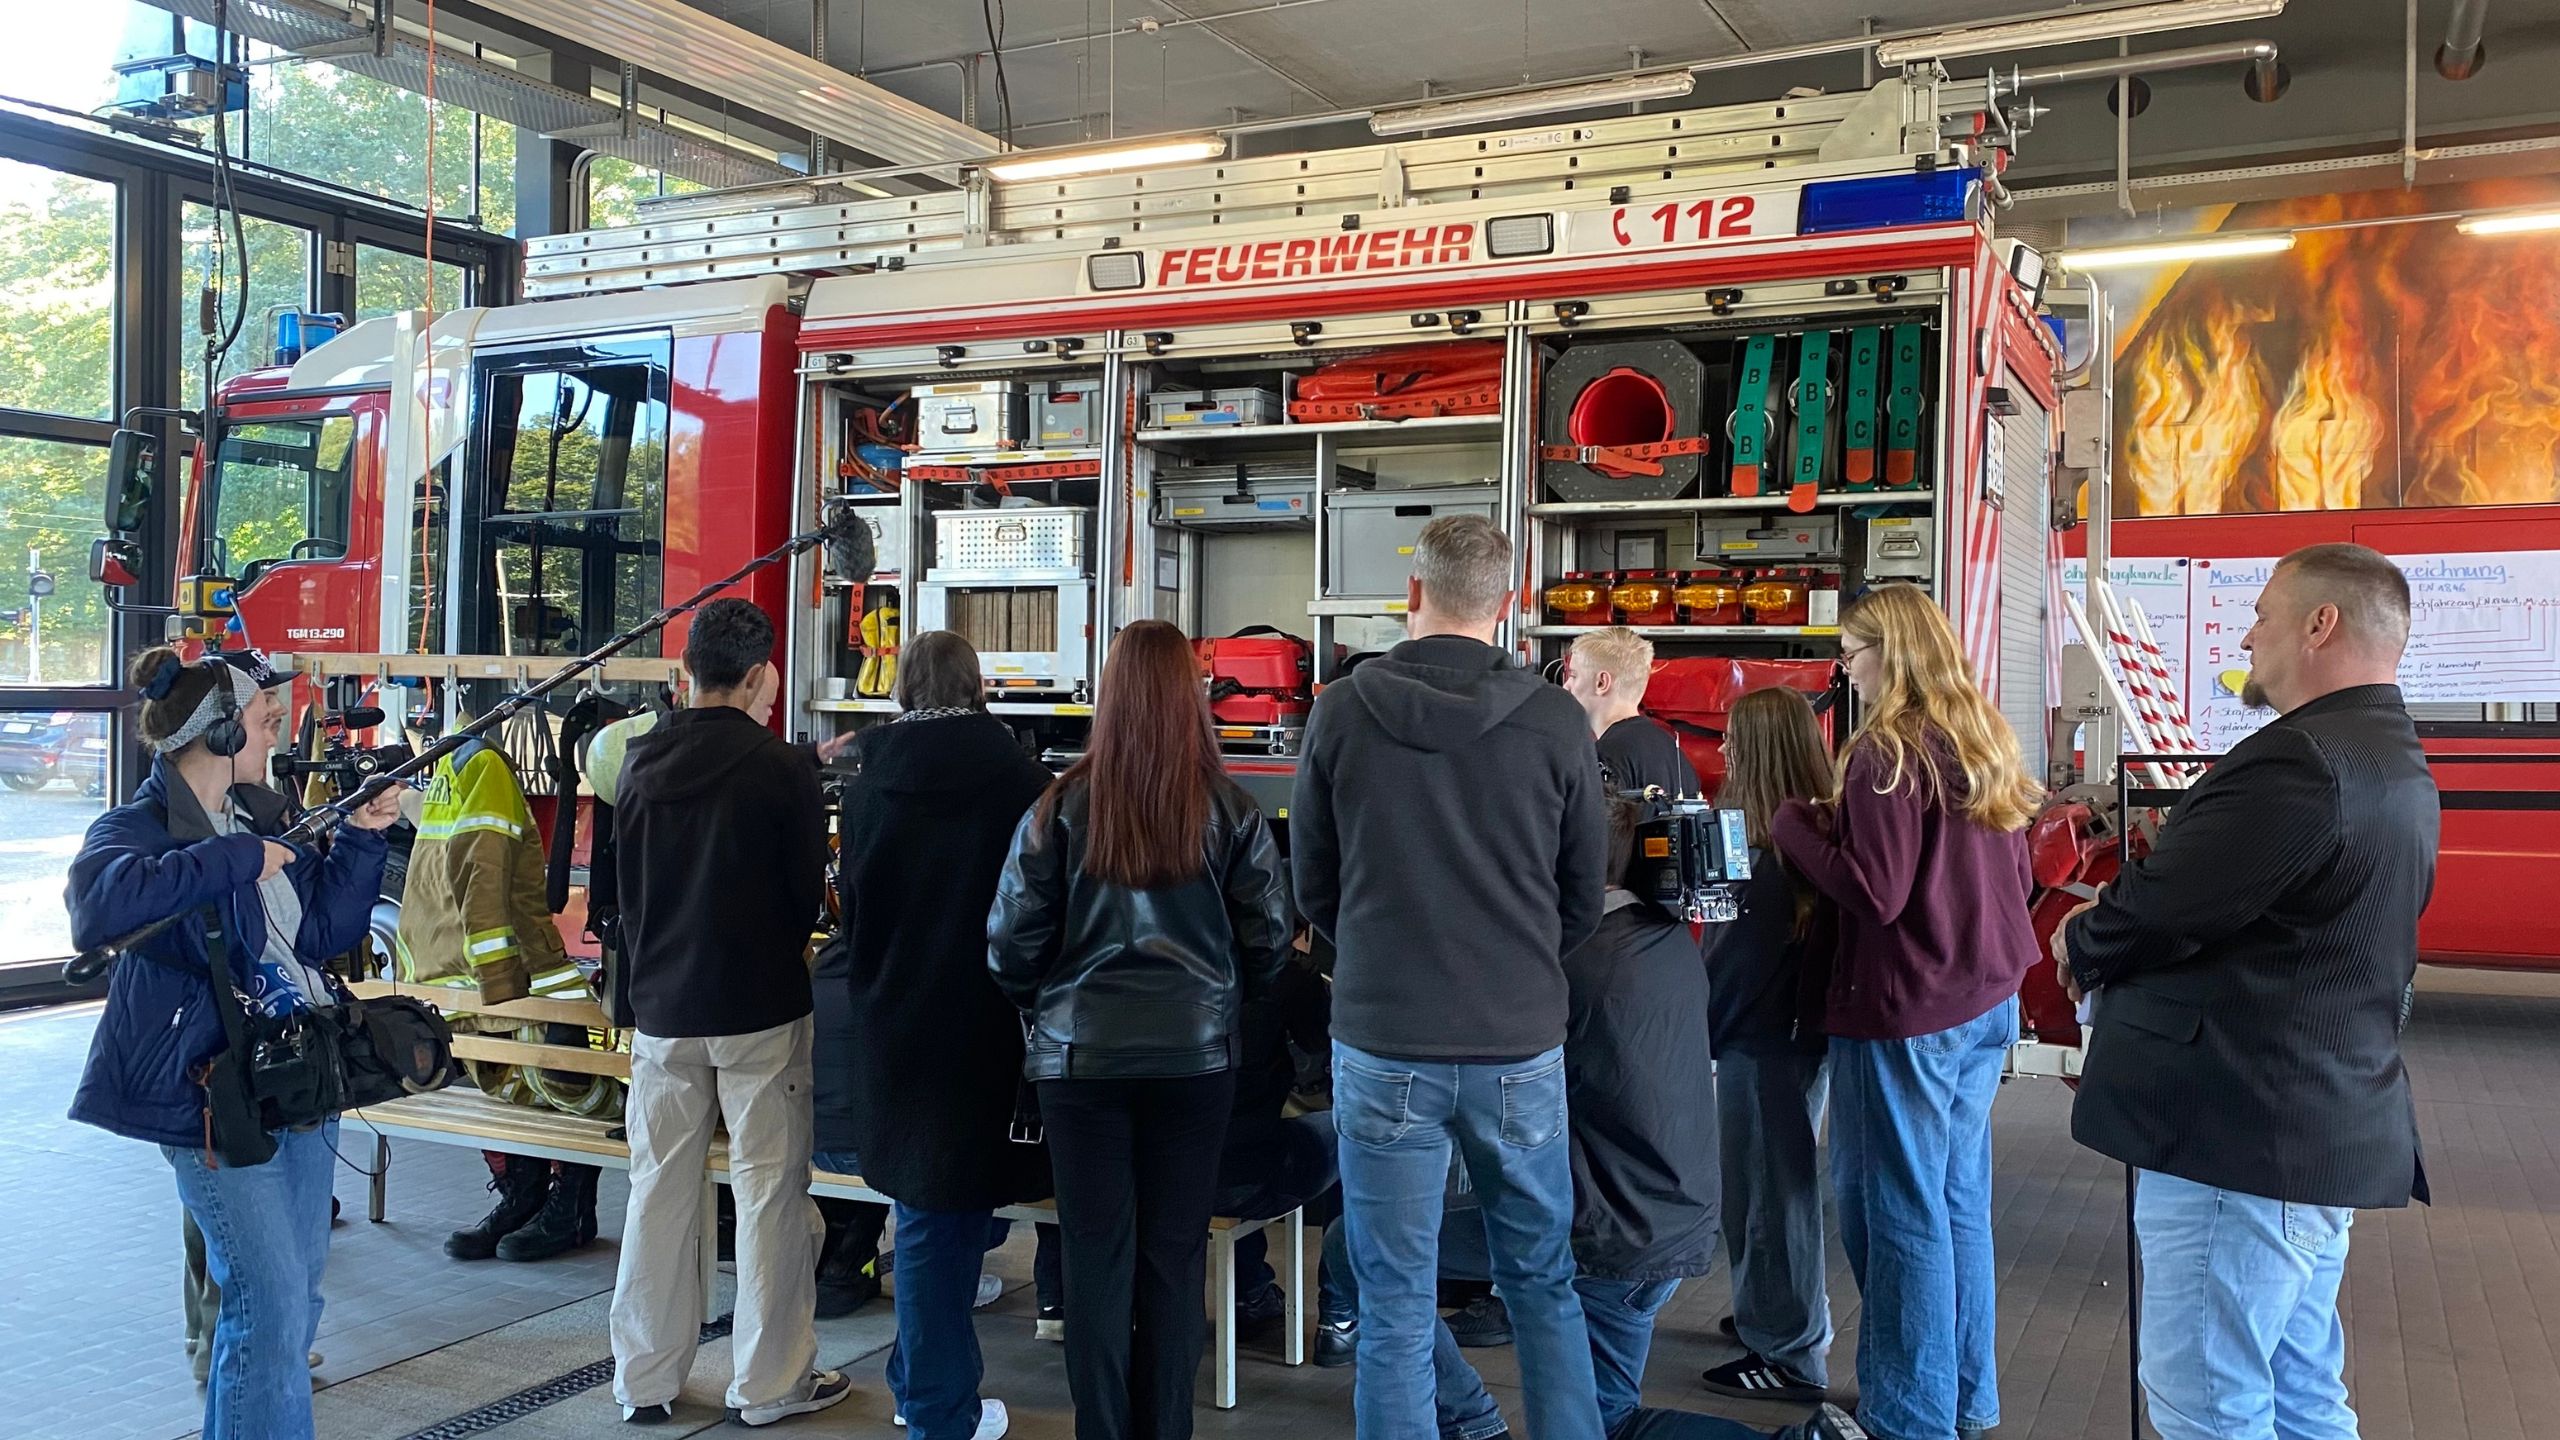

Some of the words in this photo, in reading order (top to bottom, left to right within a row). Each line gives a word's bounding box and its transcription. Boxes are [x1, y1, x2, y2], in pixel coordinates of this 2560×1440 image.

[1651, 196, 1755, 243] 112
[1157, 224, 1474, 287] FEUERWEHR
[1126, 336, 1138, 346] G3
[1857, 347, 1871, 366] C
[1900, 345, 1914, 363] C
[1747, 368, 1762, 384] B
[1805, 383, 1819, 402] B
[1854, 420, 1868, 439] C
[1897, 419, 1910, 438] C
[1740, 436, 1753, 455] B
[1801, 456, 1815, 475] B
[2405, 559, 2507, 585] zeichnung
[309, 628, 345, 639] 13.290
